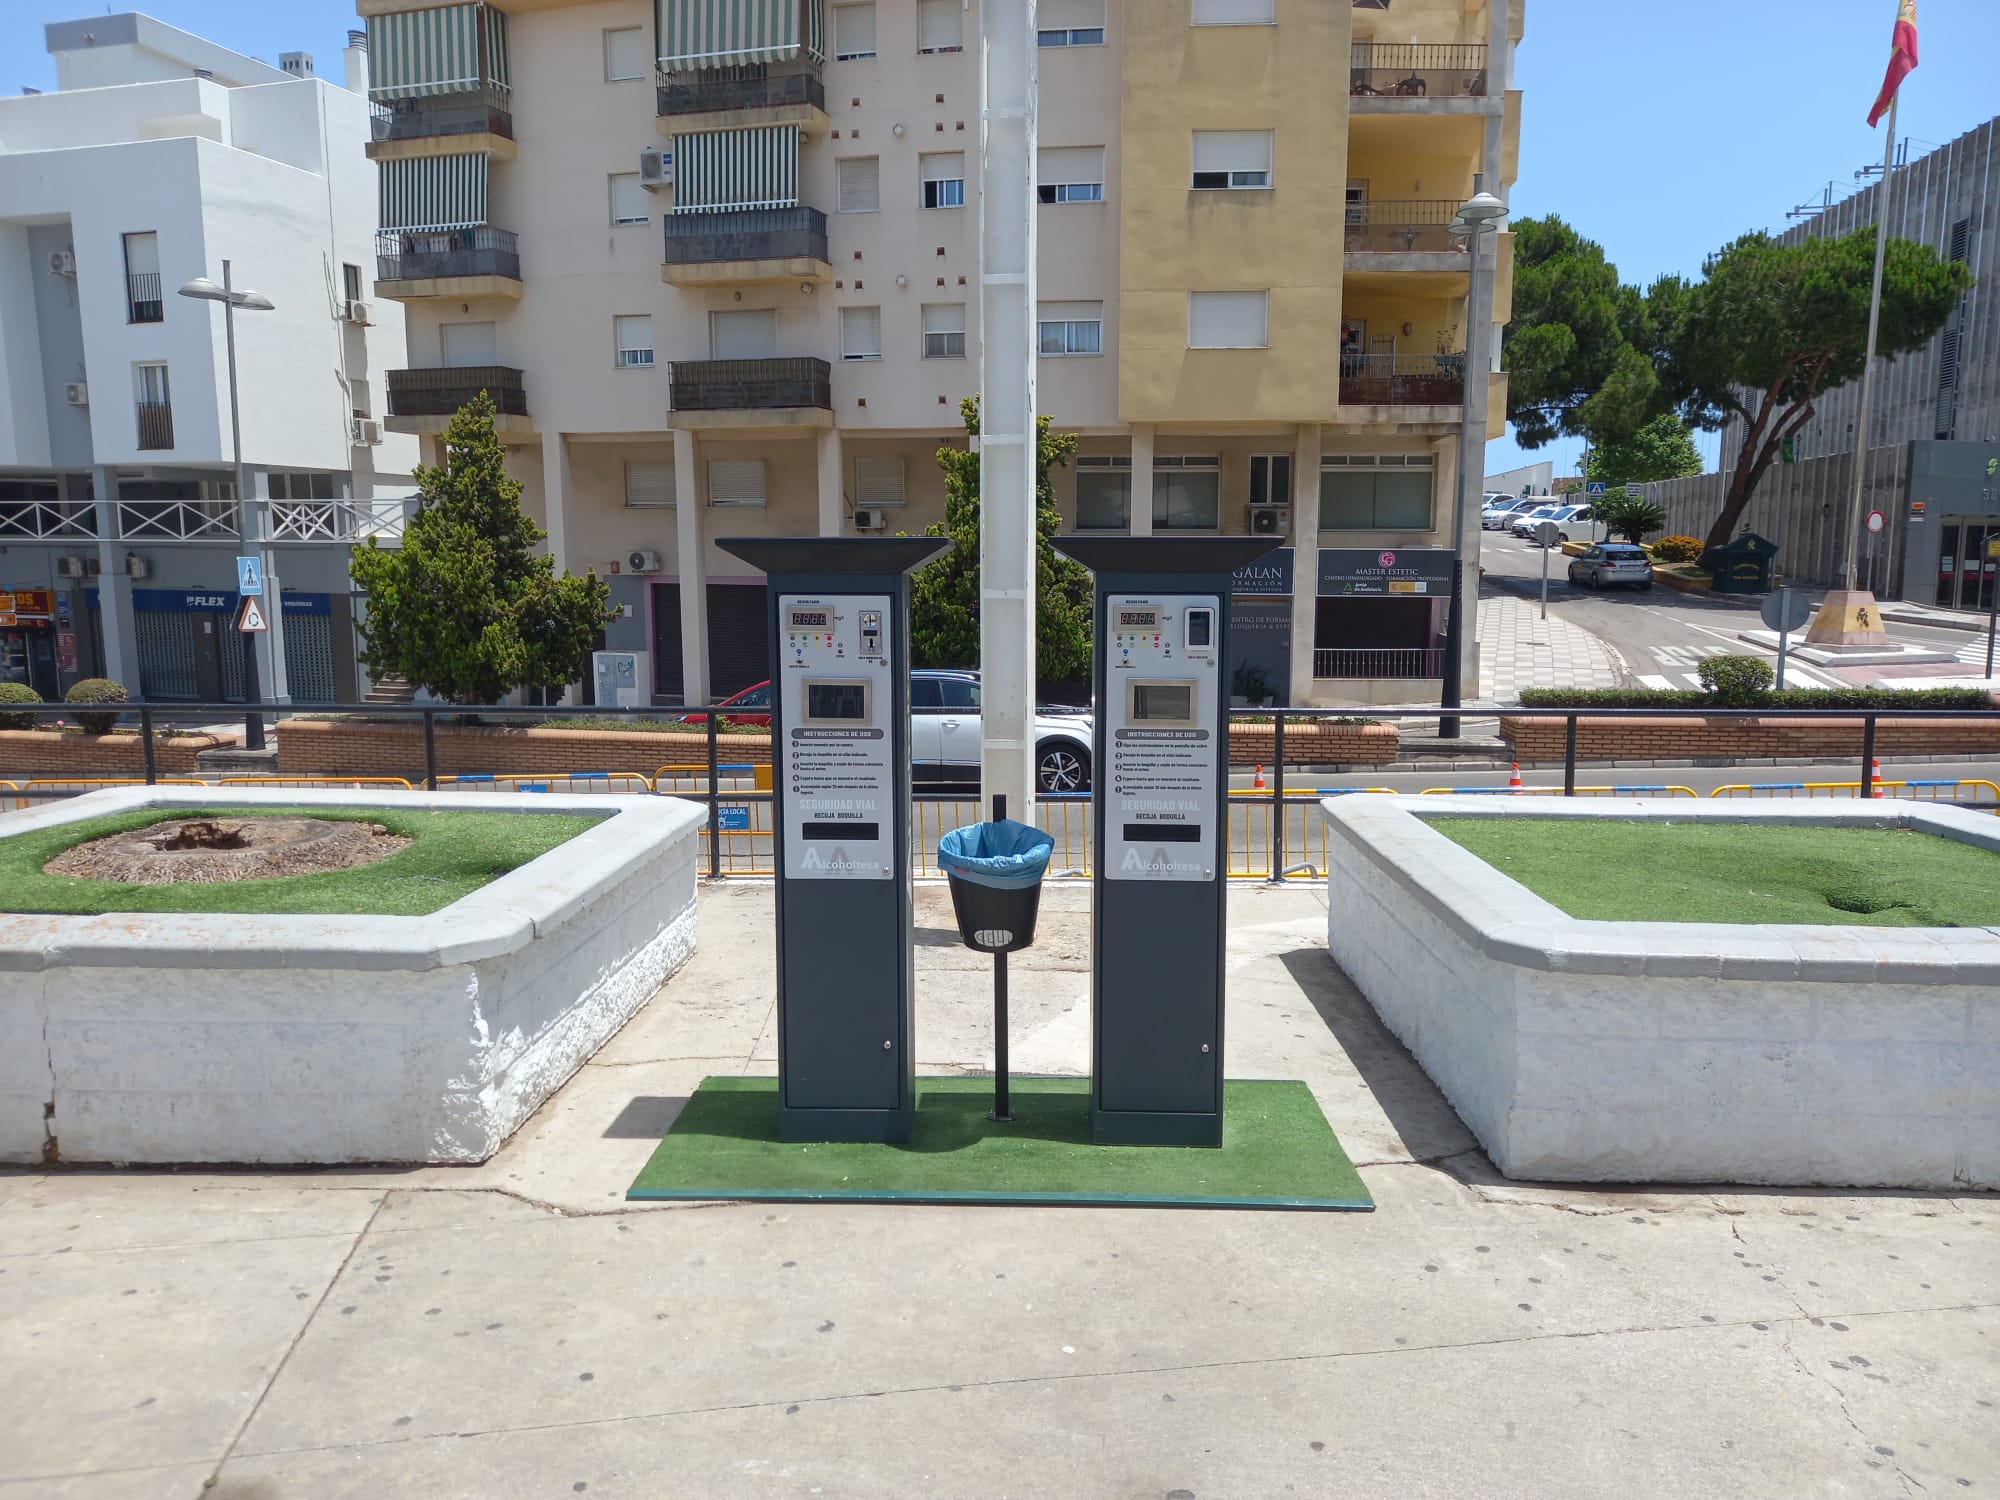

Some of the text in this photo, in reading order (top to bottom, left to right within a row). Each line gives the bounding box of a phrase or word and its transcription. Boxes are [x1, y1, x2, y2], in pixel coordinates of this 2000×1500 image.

[1232, 567, 1282, 579] GALAN
[1388, 568, 1419, 576] ESTETIC
[195, 596, 225, 606] FLEX
[800, 799, 878, 810] SEGURIDAD VIAL
[1121, 799, 1201, 812] SEGURIDAD VIAL
[837, 812, 864, 820] BOQUILLA
[1159, 813, 1186, 821] BOQUILLA
[800, 846, 880, 870] Alcoholtesa
[1120, 847, 1201, 871] Alcoholtesa
